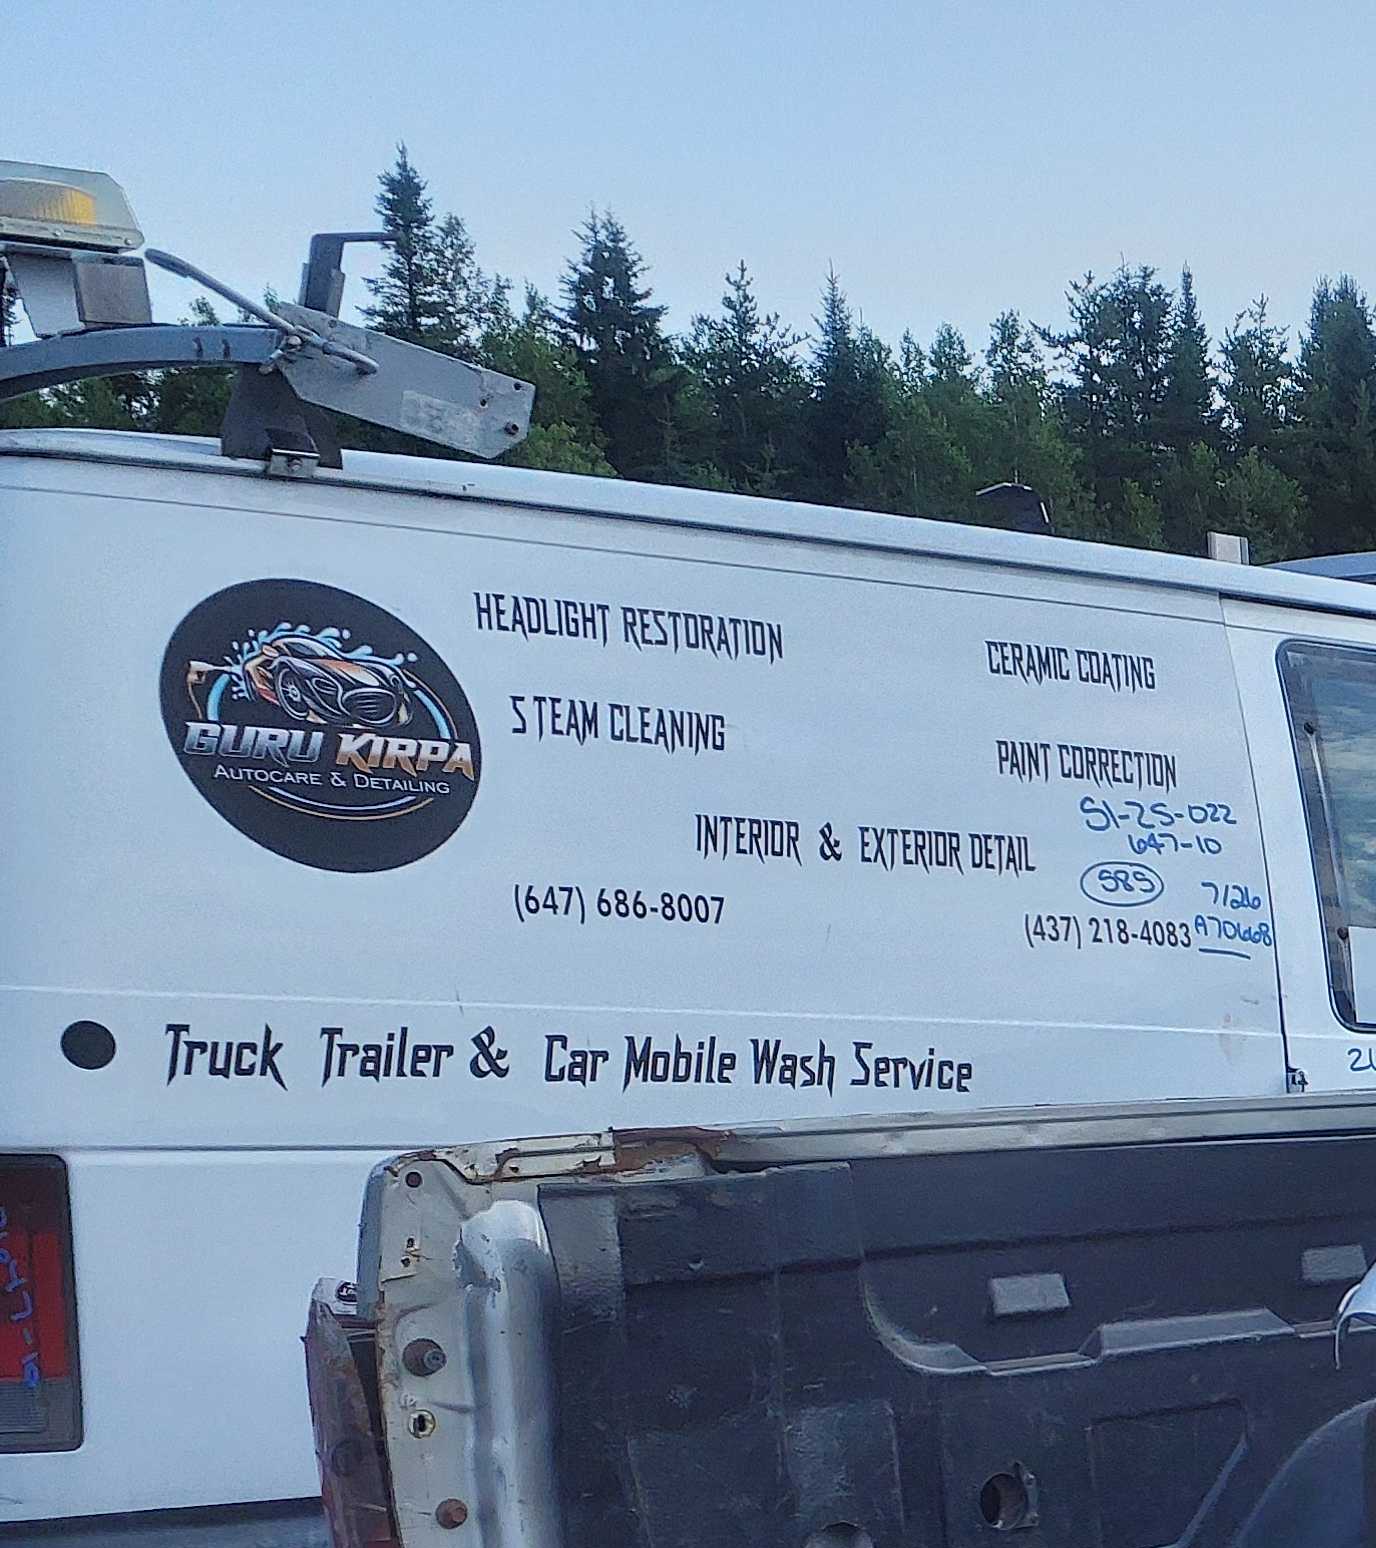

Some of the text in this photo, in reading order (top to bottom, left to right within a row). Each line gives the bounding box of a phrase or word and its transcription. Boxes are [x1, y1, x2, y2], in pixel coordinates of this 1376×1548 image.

[473, 592, 783, 664] HEADLIGHT RESTORATION
[985, 641, 1155, 694] CERAMIC COATING
[184, 721, 476, 782] GURU KIRPA
[509, 696, 725, 756] STEAM CLEANING
[213, 764, 450, 794] AUTOCARE & DETAILING
[996, 740, 1176, 794] PAINT CORRECTION
[695, 814, 1036, 878] INTERIOR & EXTERIOR DETAIL
[515, 884, 724, 924] (647) 686-8007
[1025, 914, 1191, 949] (437) 218-4083
[165, 1023, 972, 1098] Truck Trailer & Car Mobile Wash Service
